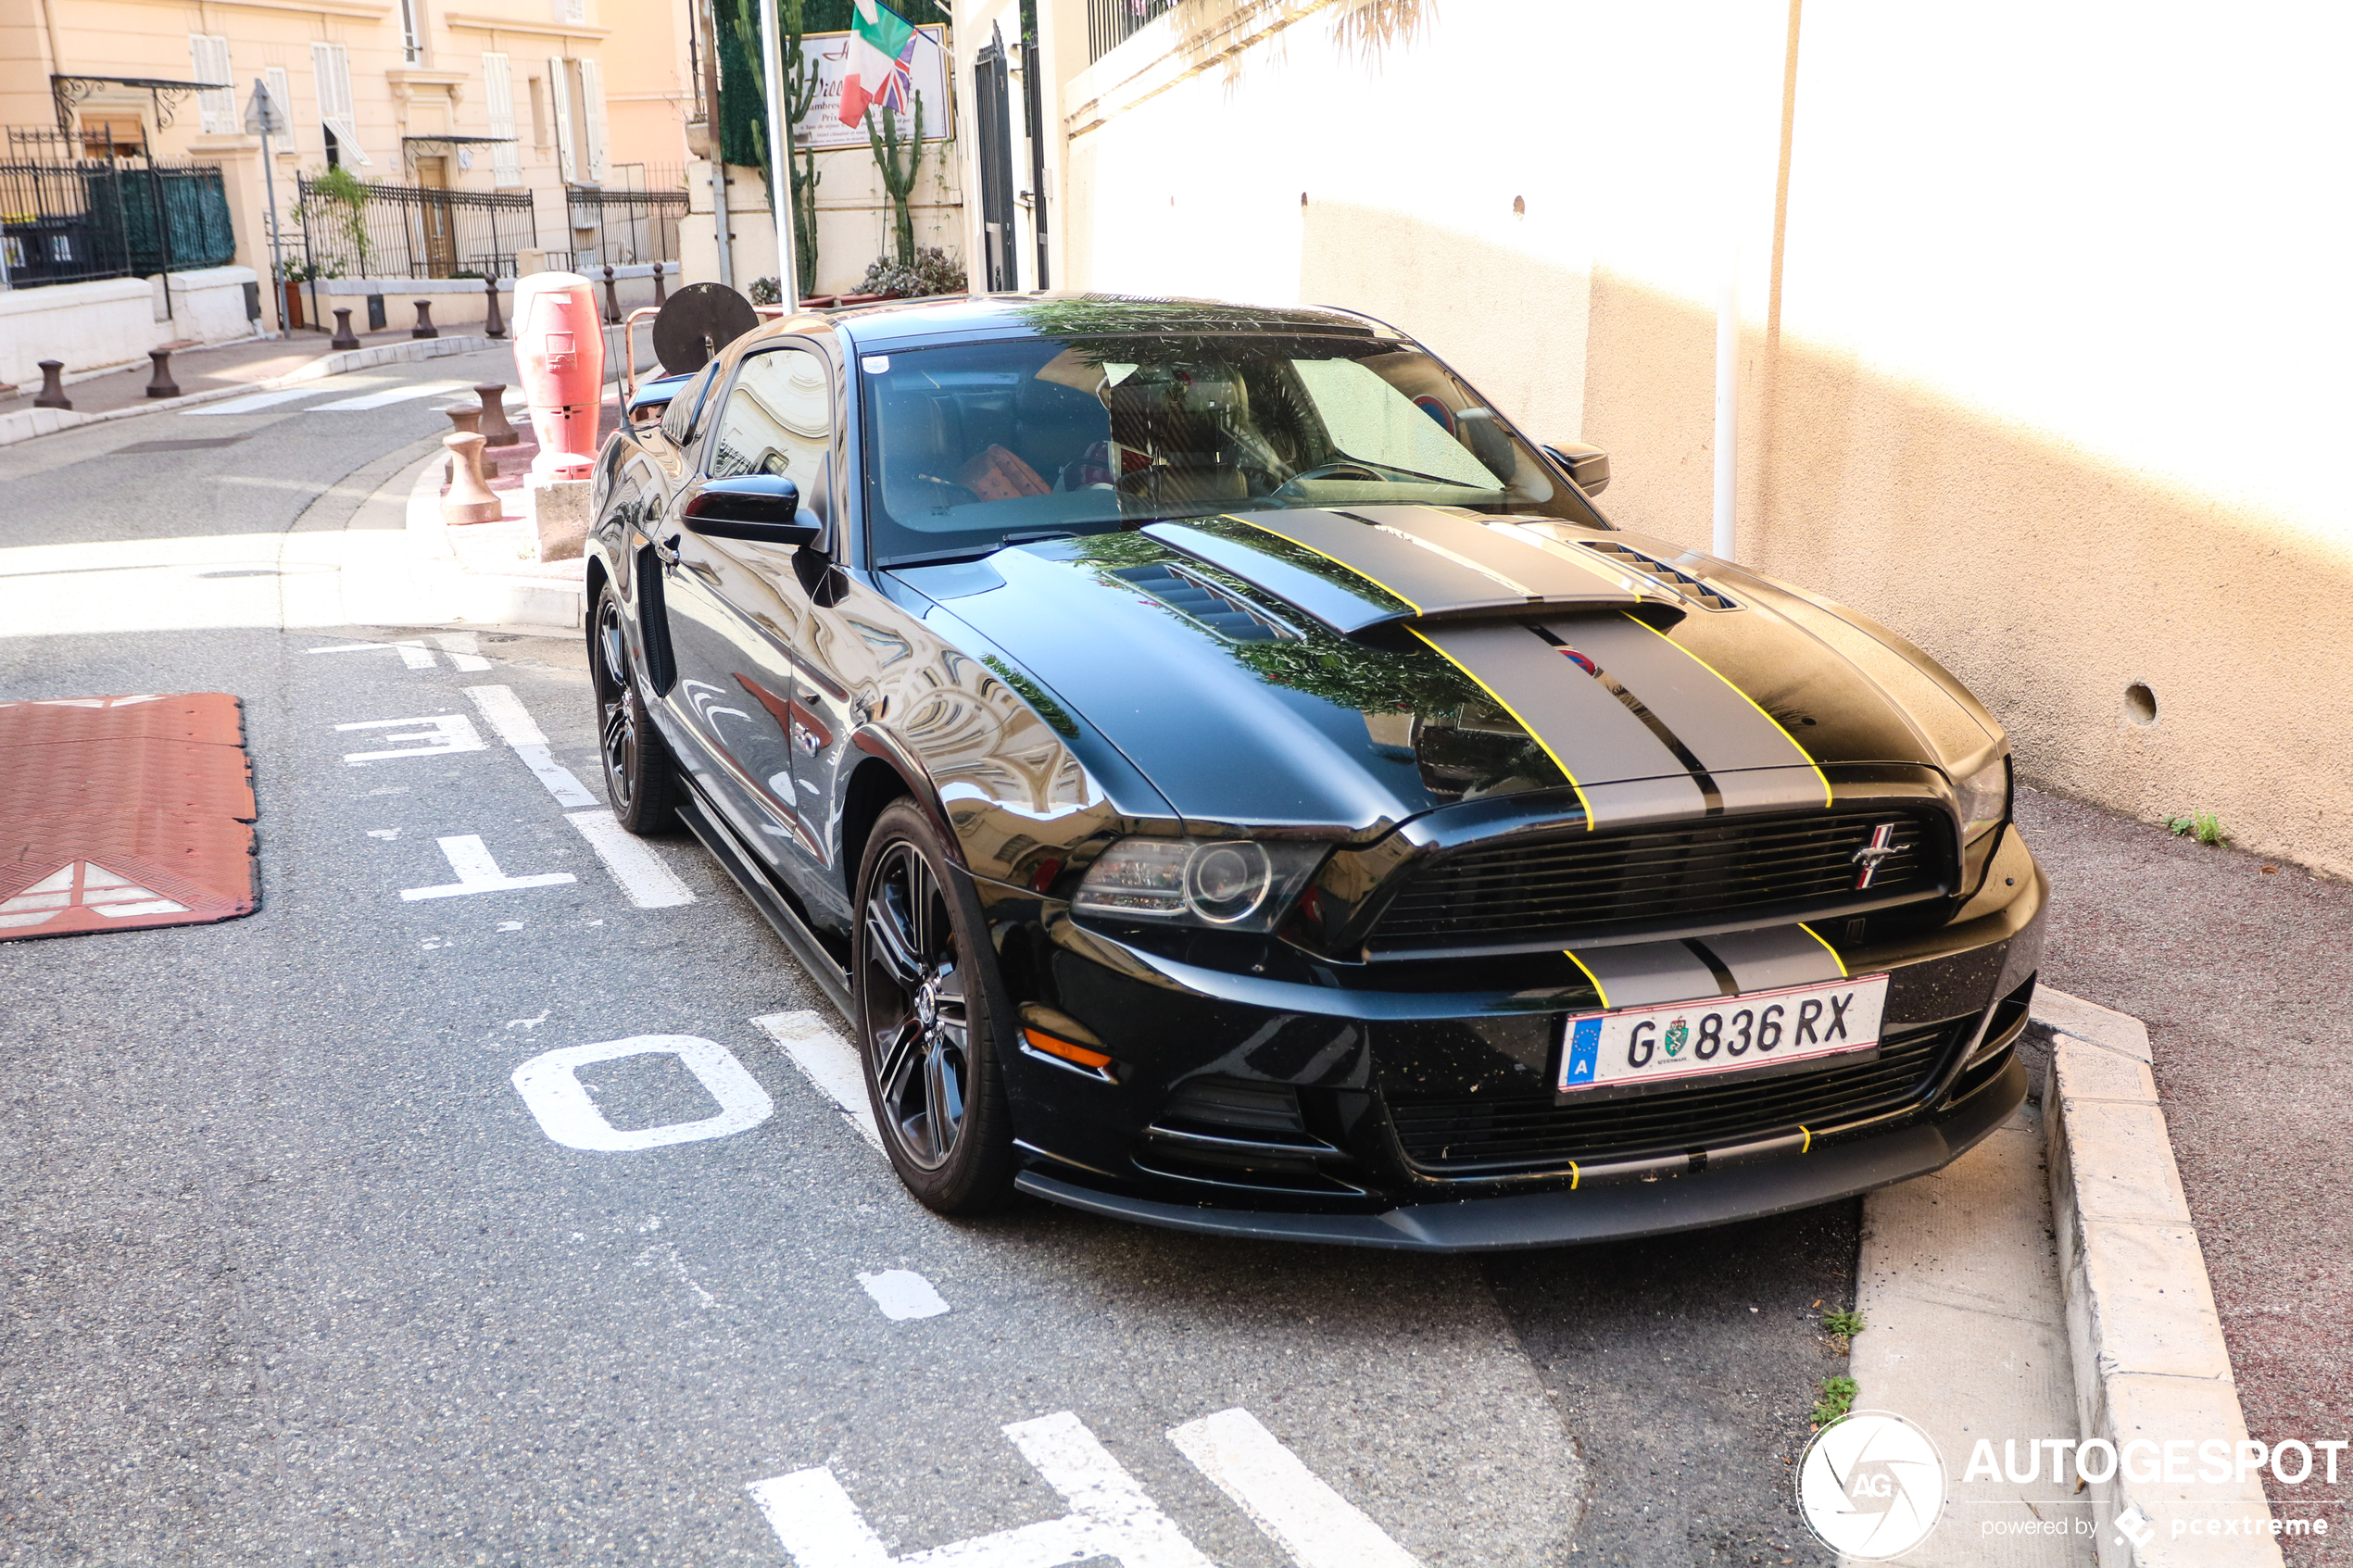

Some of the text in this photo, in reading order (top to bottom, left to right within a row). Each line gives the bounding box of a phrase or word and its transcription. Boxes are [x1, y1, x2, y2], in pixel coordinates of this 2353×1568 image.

[804, 77, 842, 97] Vill
[821, 112, 837, 122] Prix
[803, 872, 846, 914] GT/CS
[1628, 992, 1854, 1069] G 836 RX
[1575, 1059, 1588, 1075] A
